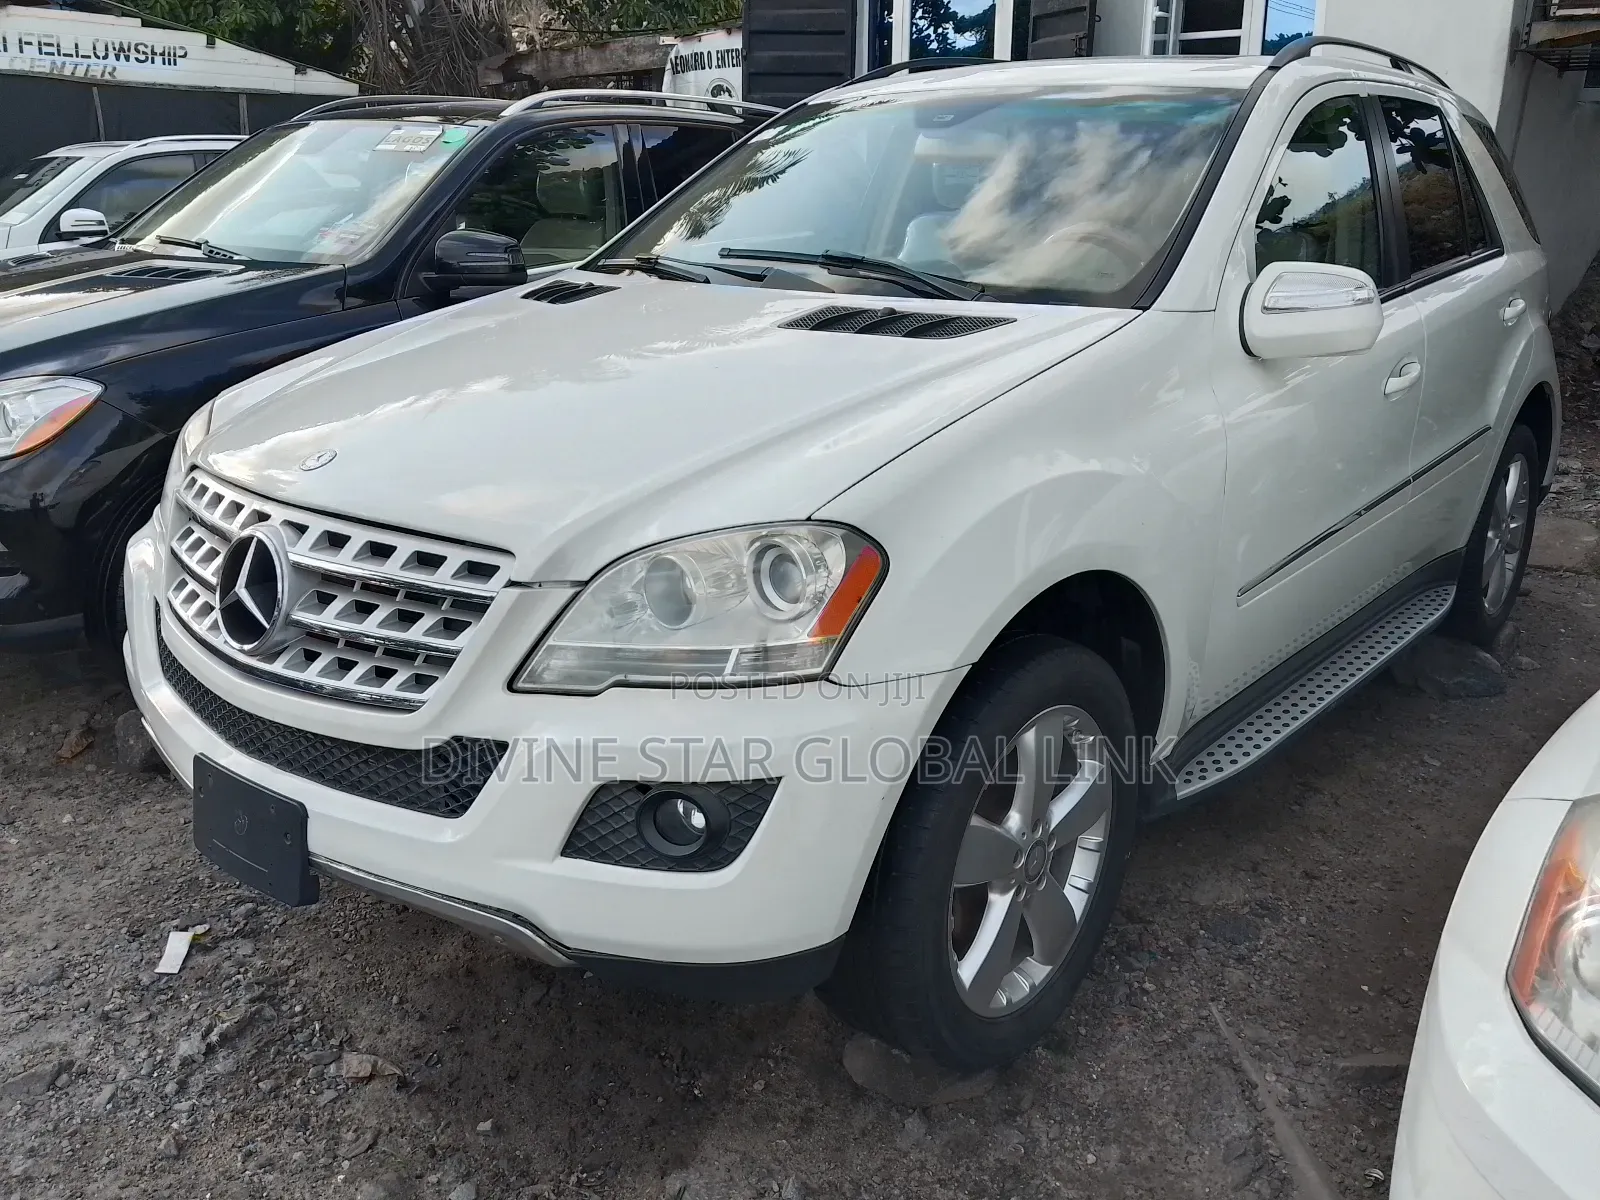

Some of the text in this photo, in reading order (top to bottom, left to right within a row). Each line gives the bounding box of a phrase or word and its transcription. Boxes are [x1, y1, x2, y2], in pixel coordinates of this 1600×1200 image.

[18, 31, 188, 66] FELLOWSHIP
[9, 57, 117, 79] CENTER
[384, 135, 433, 144] LAGOS
